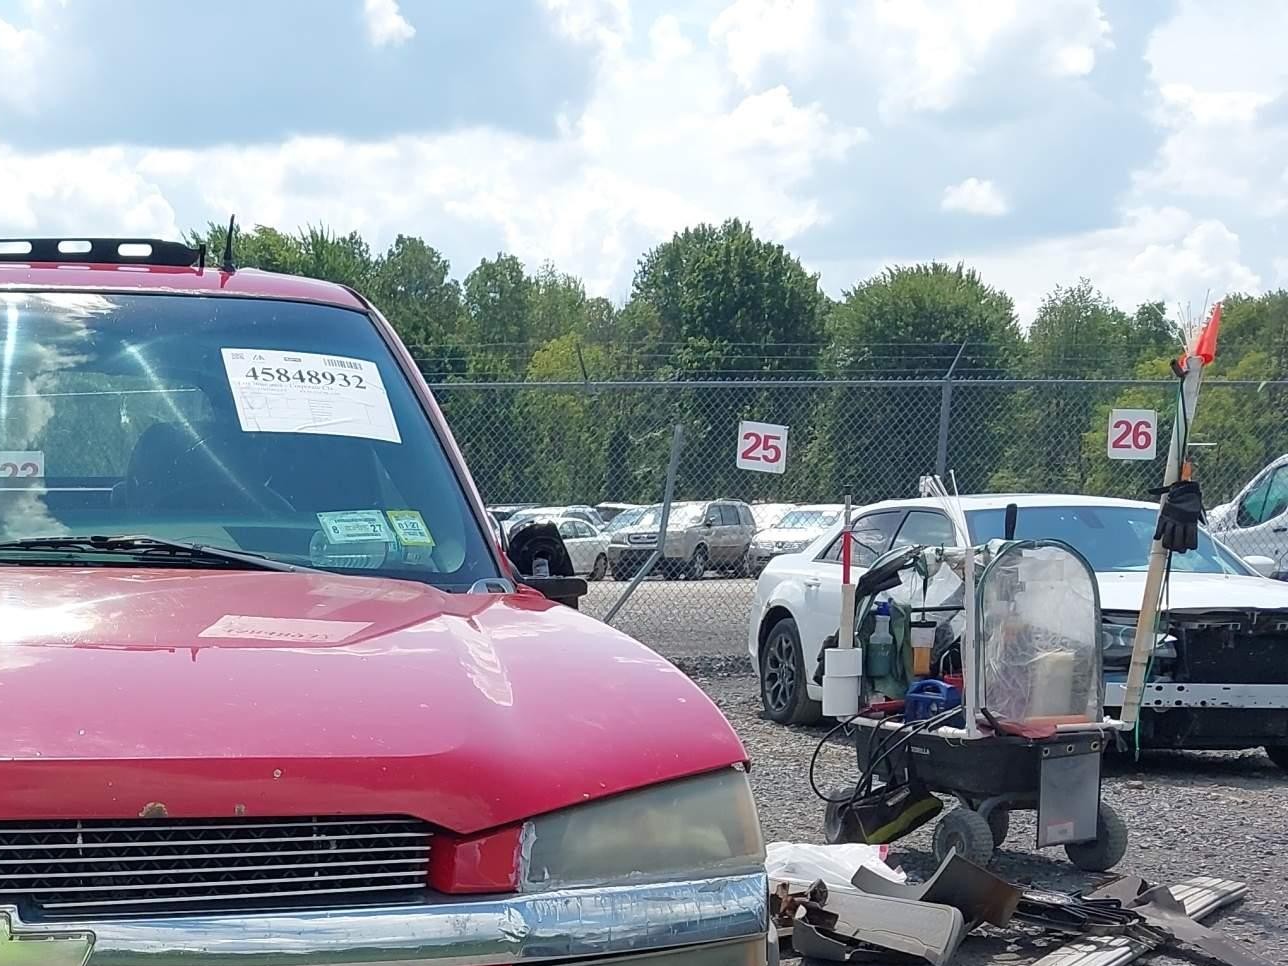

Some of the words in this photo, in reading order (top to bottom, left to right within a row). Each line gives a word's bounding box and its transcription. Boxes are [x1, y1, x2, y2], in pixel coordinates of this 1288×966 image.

[245, 366, 367, 389] 45848932
[741, 432, 782, 463] 25
[1112, 420, 1152, 449] 26
[370, 524, 382, 533] 27
